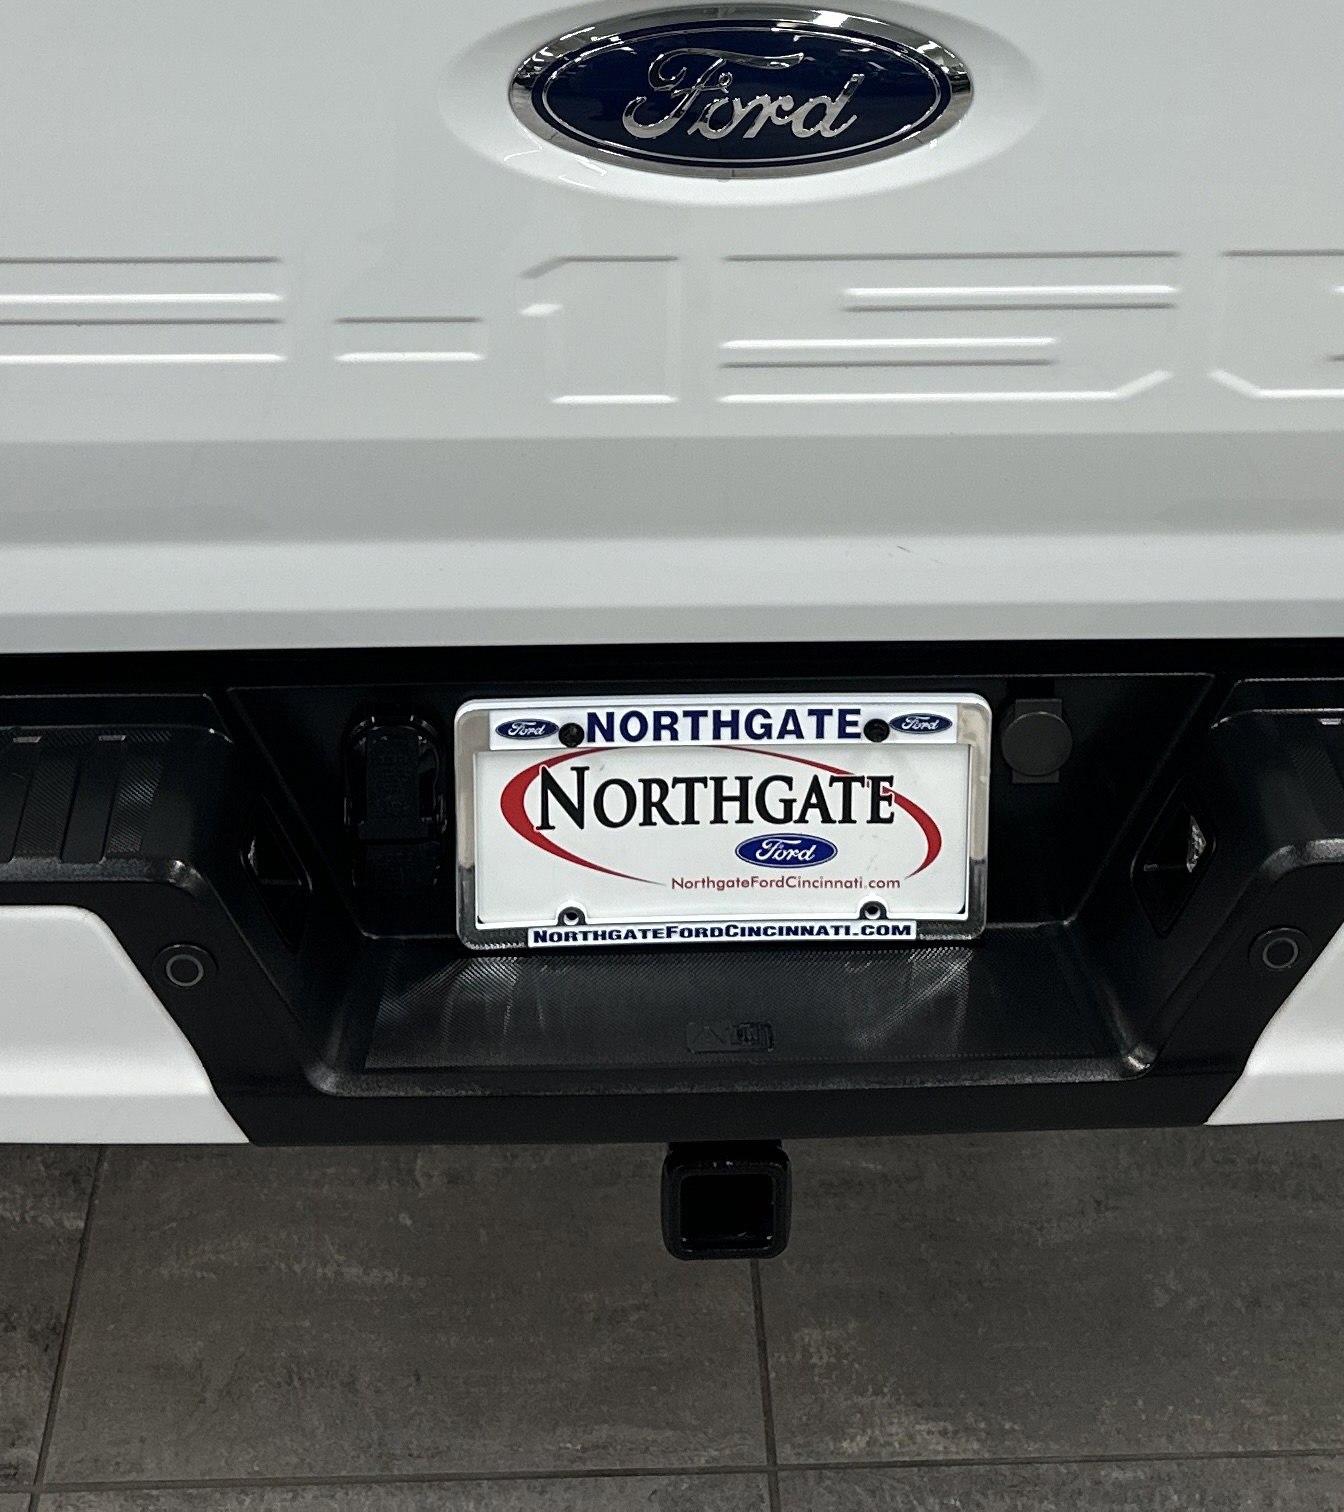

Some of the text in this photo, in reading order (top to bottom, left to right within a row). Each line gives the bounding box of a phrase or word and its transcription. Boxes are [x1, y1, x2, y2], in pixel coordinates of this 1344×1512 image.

[621, 47, 866, 140] Ford
[507, 720, 547, 737] Ford
[586, 708, 862, 743] NORTHGATE
[901, 715, 940, 730] Ford
[755, 838, 817, 861] Ford
[671, 876, 901, 891] NorthgateFordCincinnati.com
